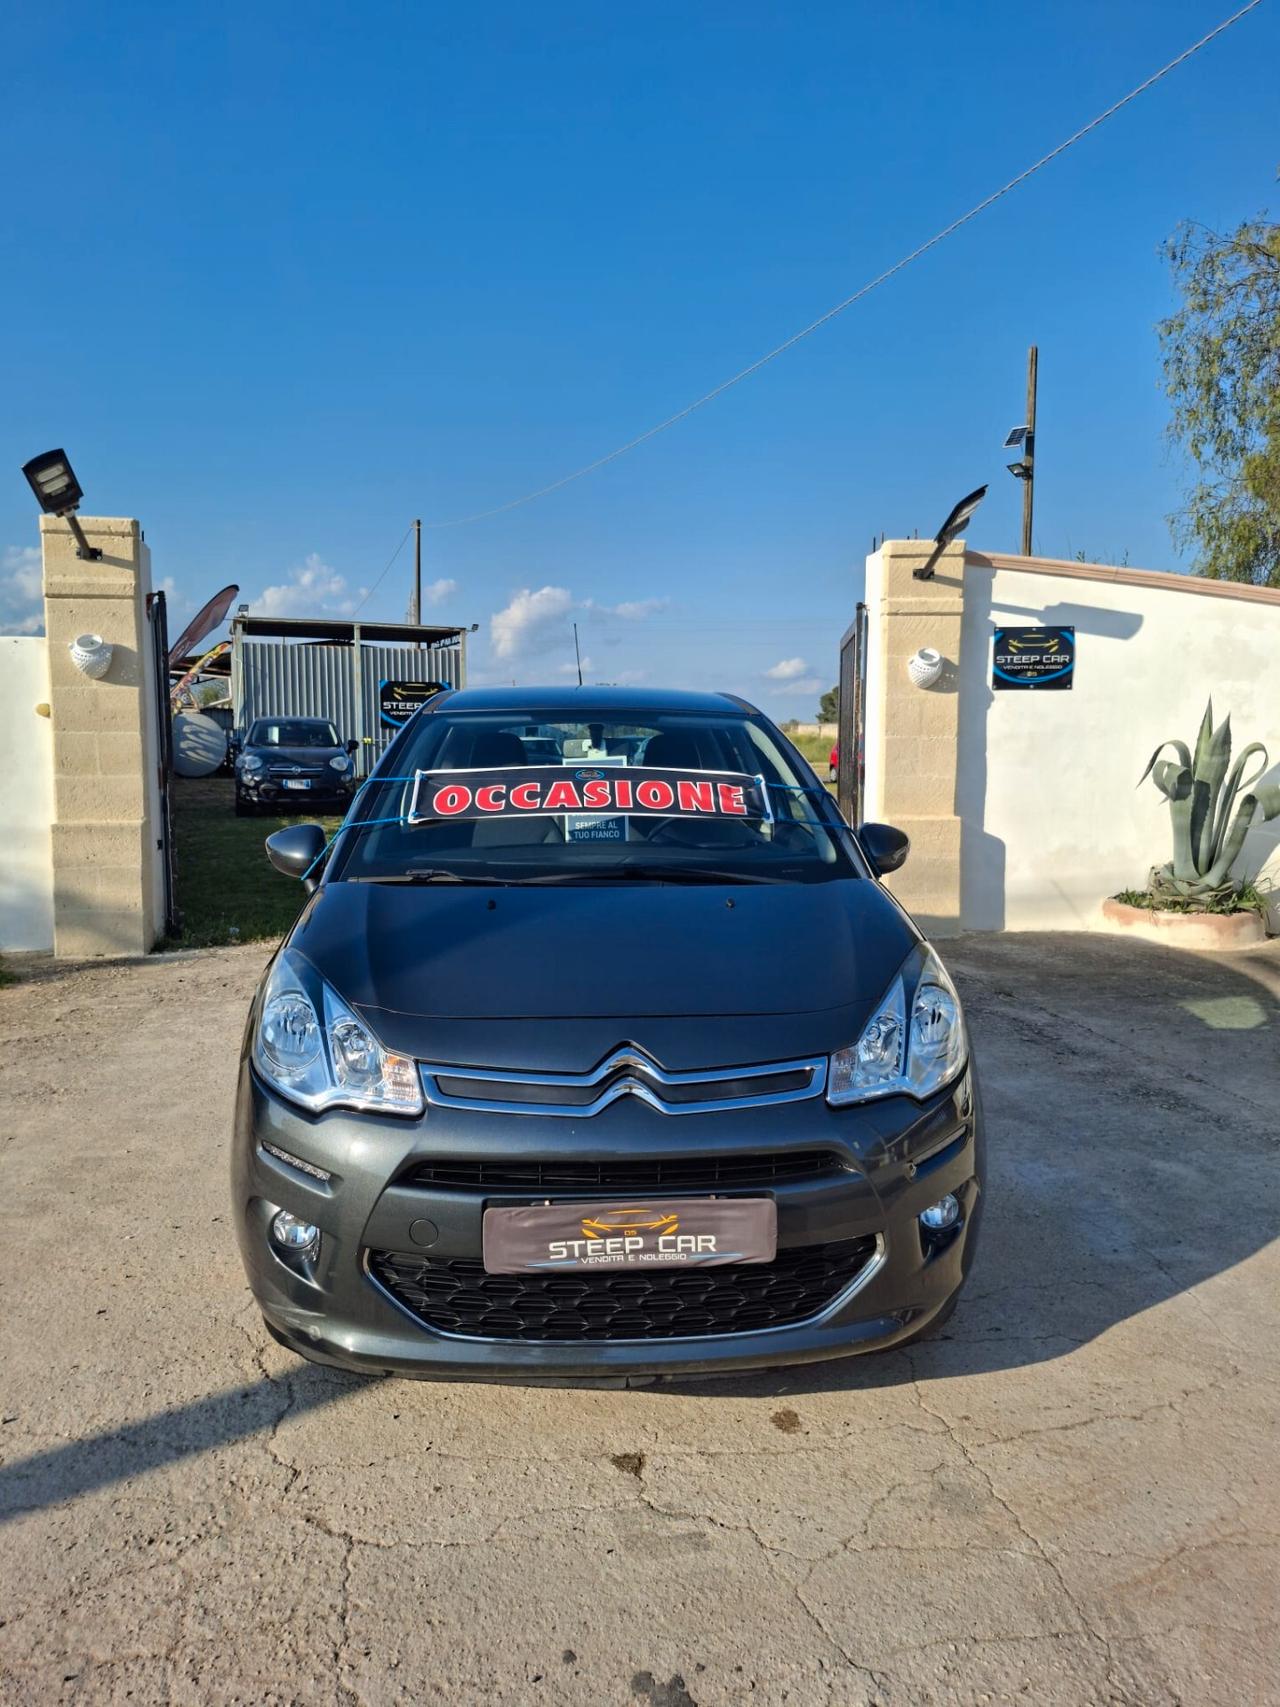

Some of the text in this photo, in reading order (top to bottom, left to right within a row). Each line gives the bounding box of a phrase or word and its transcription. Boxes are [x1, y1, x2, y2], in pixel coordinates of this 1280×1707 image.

[996, 655, 1070, 664] STEEP CAR
[432, 780, 748, 816] OCCASIONE
[575, 821, 618, 830] SEMPRE AL
[574, 830, 620, 839] TUO FIANCO
[549, 1235, 717, 1259] STEEP CAR
[580, 1253, 687, 1264] VENDITA E NOLEGGIO
